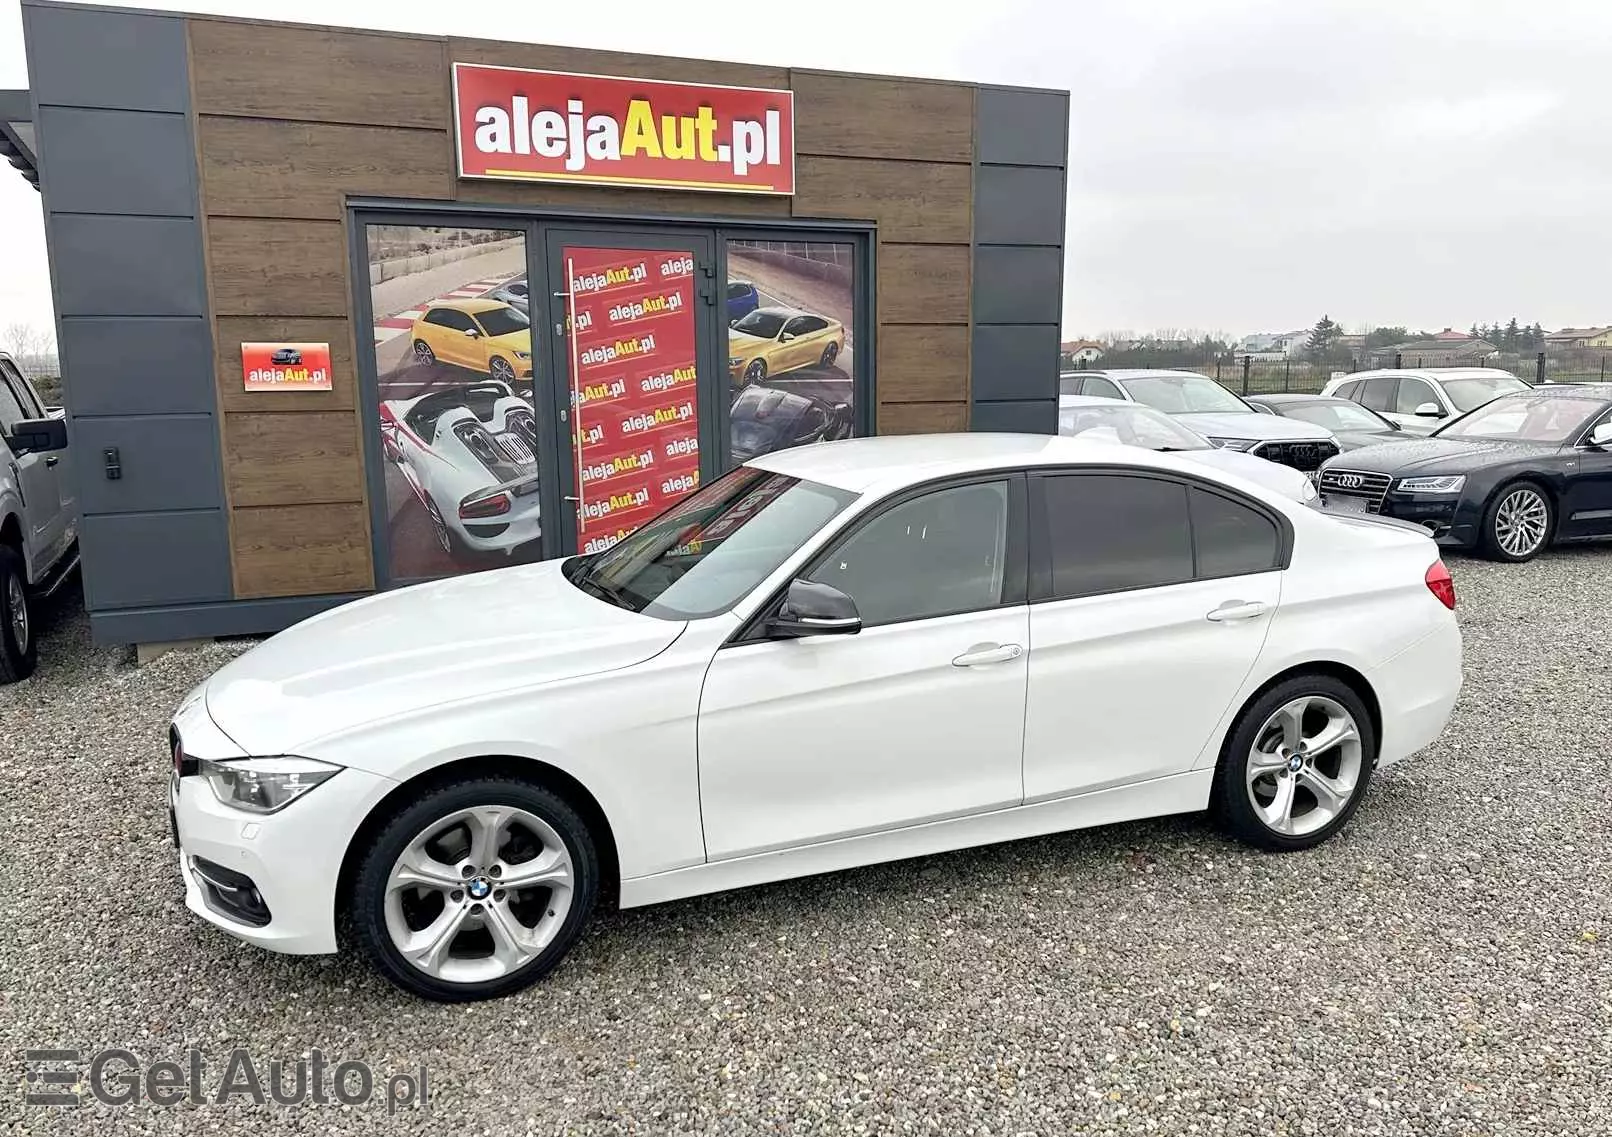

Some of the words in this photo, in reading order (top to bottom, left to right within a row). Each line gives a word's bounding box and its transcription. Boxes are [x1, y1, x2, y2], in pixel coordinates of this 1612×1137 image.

[474, 96, 780, 176] alejaAut.pl
[573, 262, 647, 292] alejaAut.pl
[660, 257, 693, 276] aleja
[608, 291, 682, 321] alejaAut.pl
[581, 334, 656, 365] alejaAut.pl
[249, 367, 327, 384] alejaAut.pl
[621, 402, 693, 433] alejaAut.pl
[665, 437, 699, 456] aleja
[582, 450, 654, 482] alejaAut.pl
